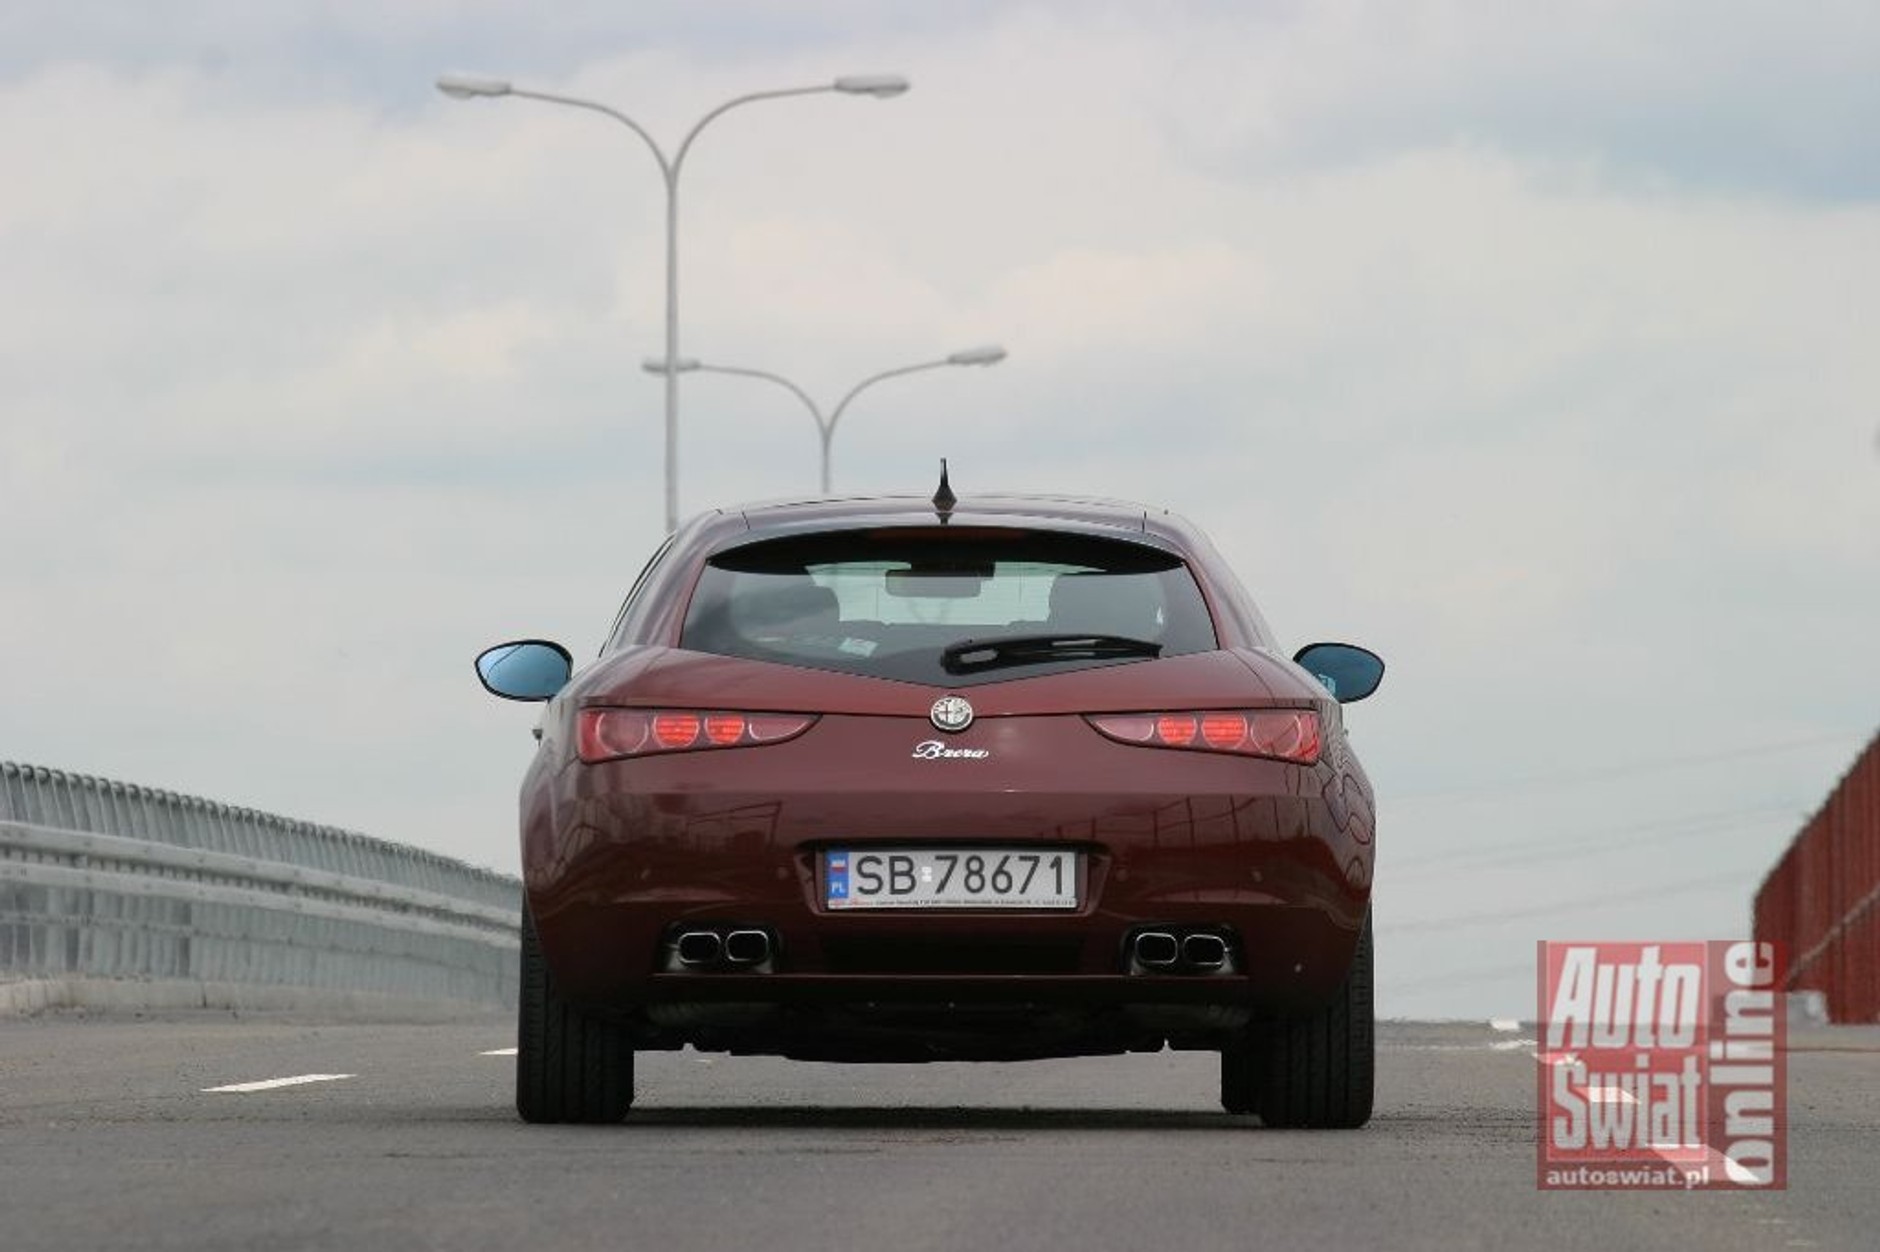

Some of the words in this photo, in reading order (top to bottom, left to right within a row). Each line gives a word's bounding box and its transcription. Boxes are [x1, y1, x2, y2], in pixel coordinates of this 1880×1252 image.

[912, 740, 989, 760] Brera
[856, 855, 917, 895] SB
[934, 855, 1063, 895] 78671
[831, 882, 846, 893] PL
